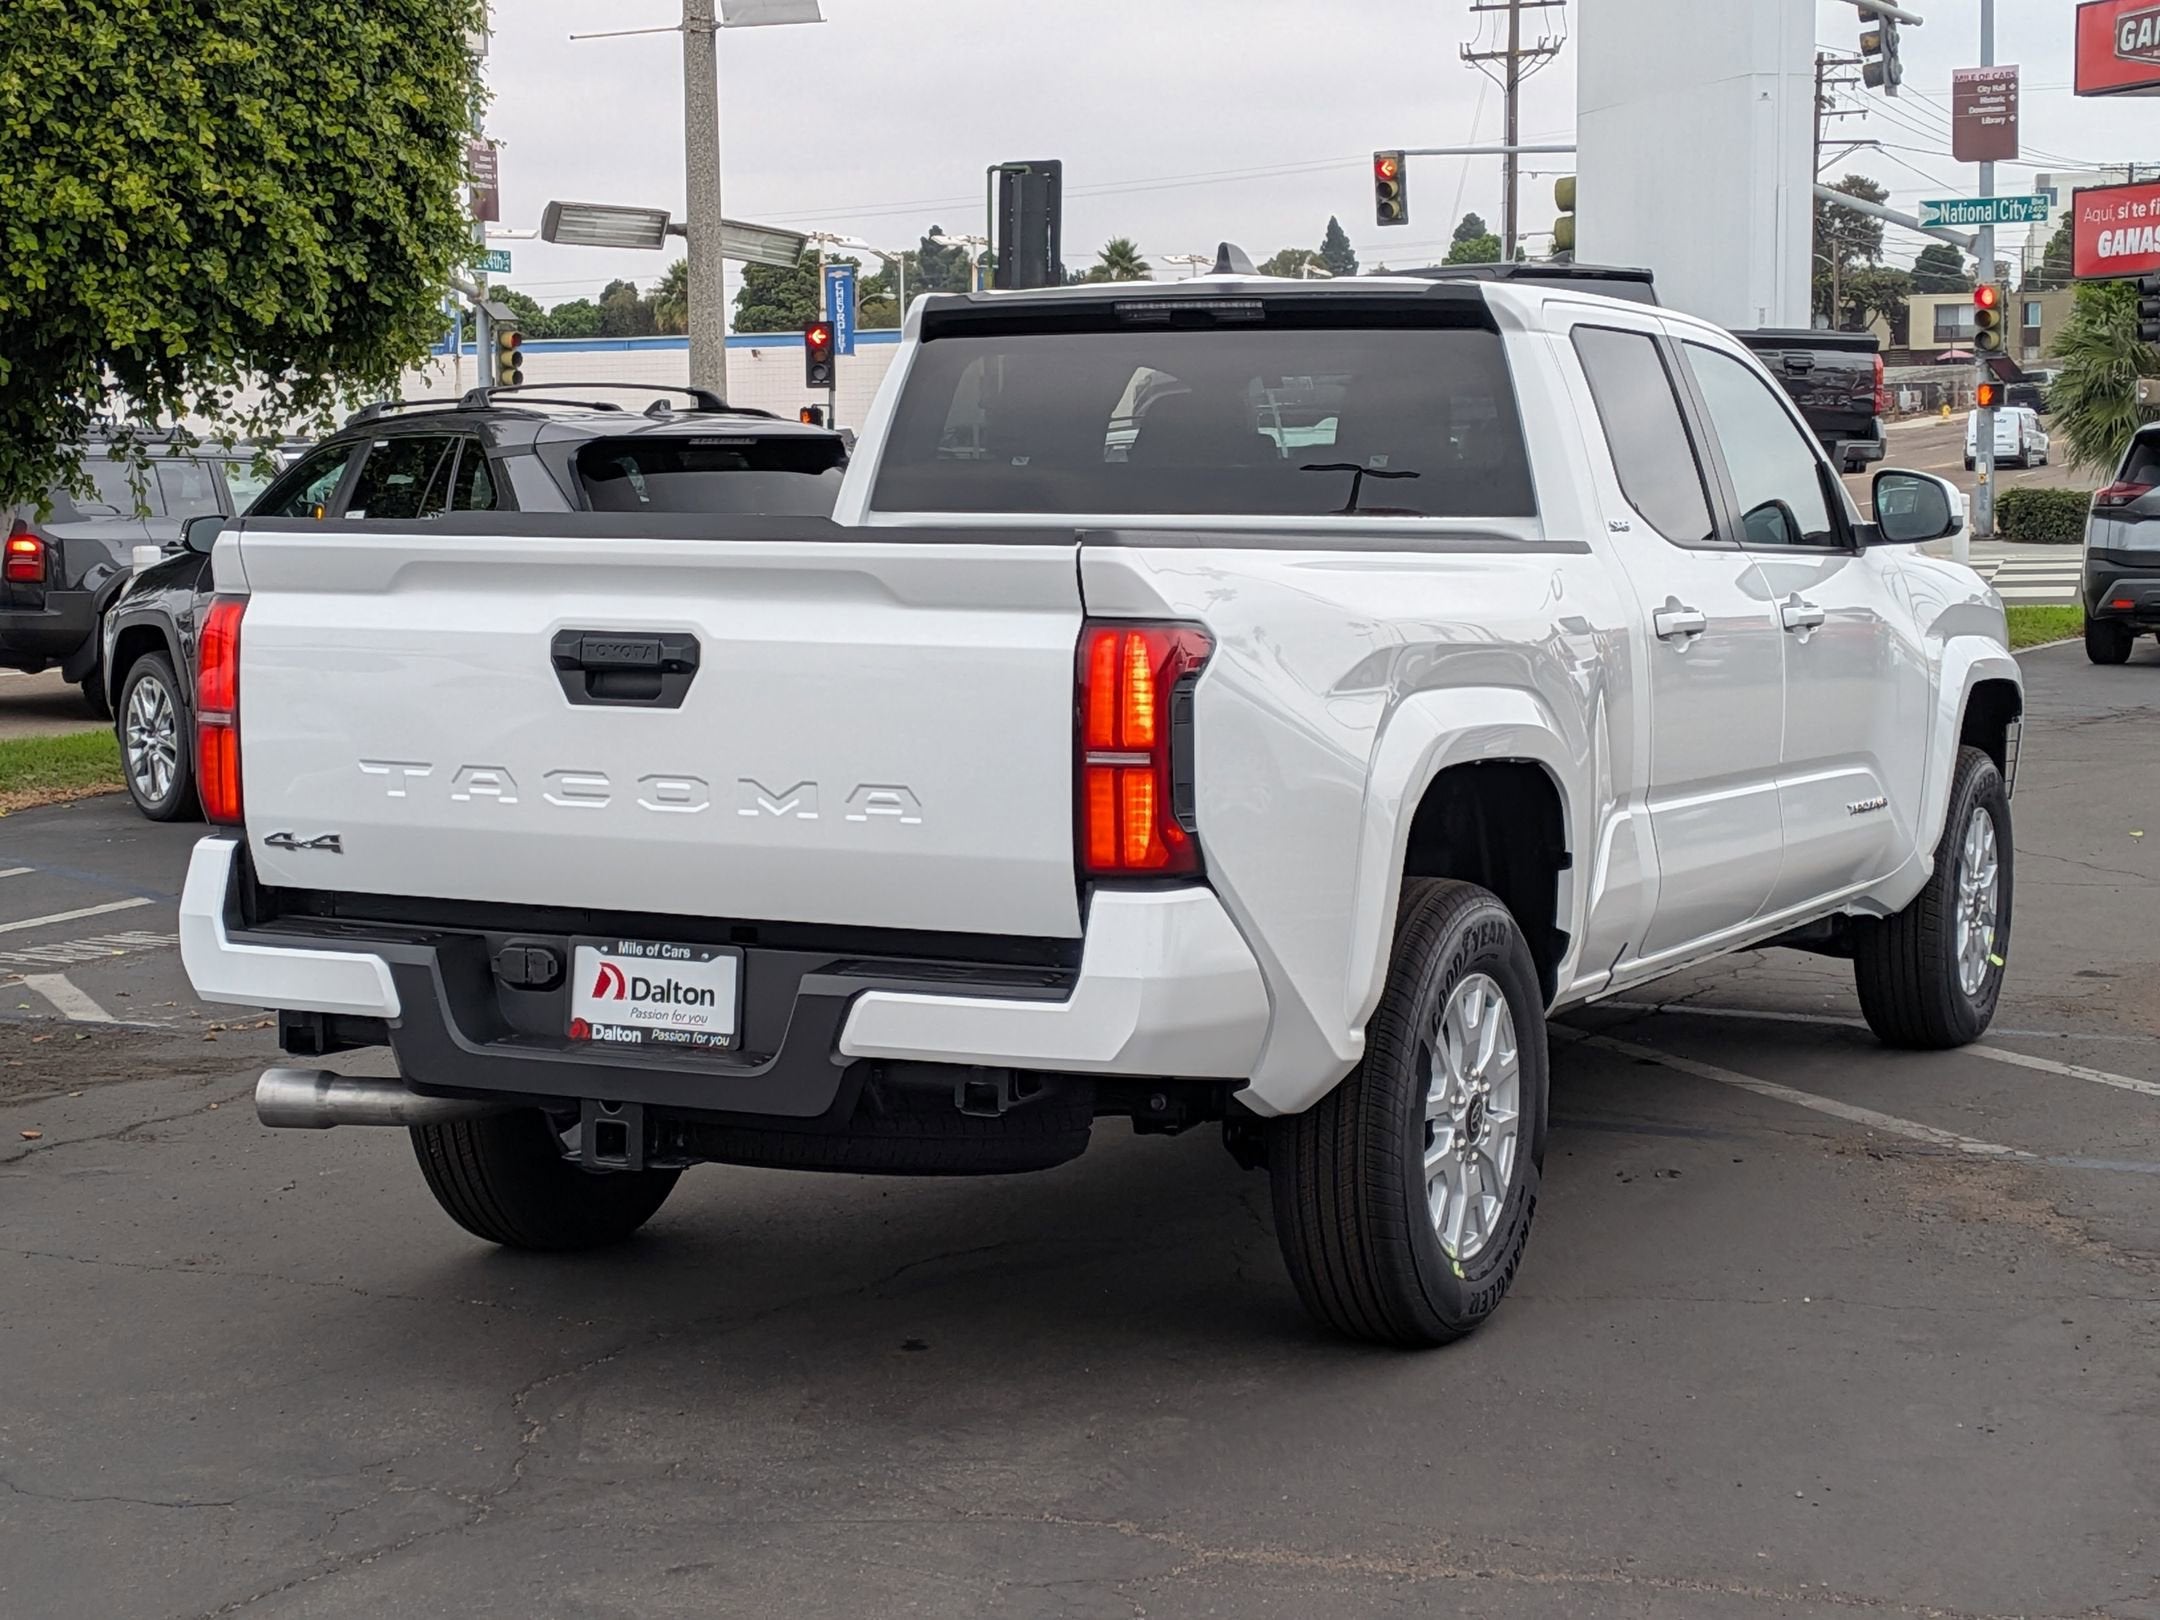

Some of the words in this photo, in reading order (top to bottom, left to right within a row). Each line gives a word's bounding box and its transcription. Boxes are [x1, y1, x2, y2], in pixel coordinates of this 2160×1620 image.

[2120, 16, 2160, 51] GA
[1979, 73, 1990, 81] OF
[1992, 71, 2016, 80] CARS
[1977, 85, 1991, 94] City
[1981, 116, 2006, 125] Library
[1940, 201, 1996, 223] National
[2000, 199, 2028, 221] City
[2083, 204, 2116, 224] Aquí,
[2117, 201, 2131, 219] sí
[2132, 202, 2147, 218] te
[835, 281, 846, 354] CHEVROLET
[585, 643, 652, 660] TOYOTA
[359, 758, 923, 824] TACOMA
[618, 941, 643, 956] Mile
[646, 943, 659, 957] of
[662, 945, 691, 959] Cars
[630, 976, 715, 1007] Dalton
[630, 1007, 669, 1021] Passion
[672, 1009, 687, 1022] for
[688, 1014, 708, 1024] you
[591, 1024, 642, 1043] Dalton
[651, 1029, 690, 1042] Passion
[692, 1034, 708, 1044] for
[708, 1036, 730, 1047] you
